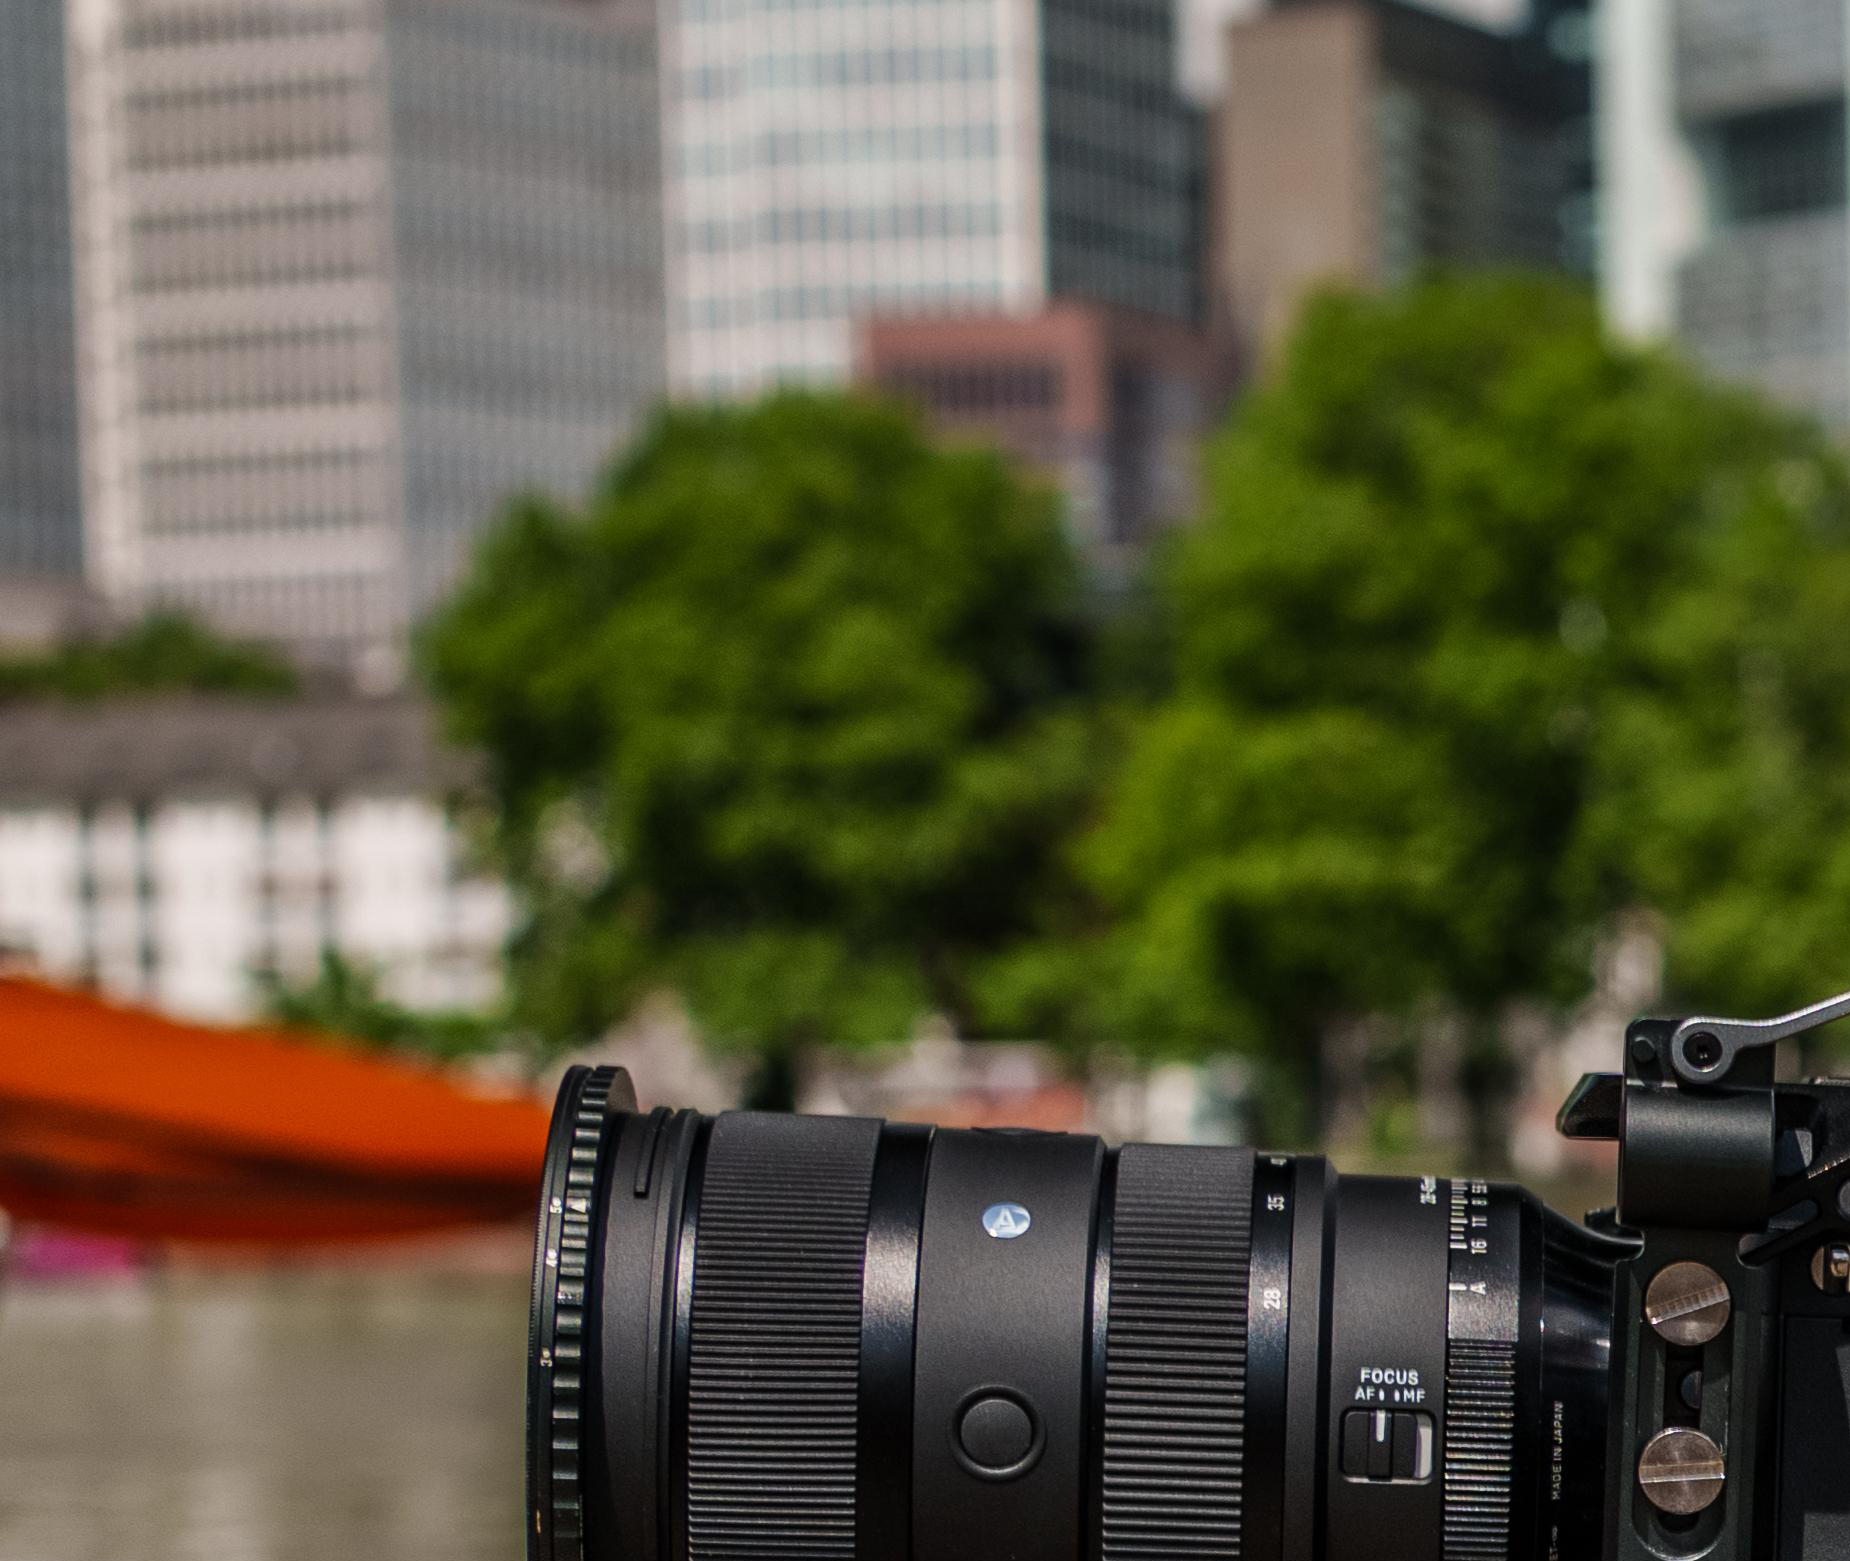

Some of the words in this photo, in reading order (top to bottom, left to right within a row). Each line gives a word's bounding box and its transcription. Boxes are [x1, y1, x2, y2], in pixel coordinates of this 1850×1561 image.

[1267, 1194, 1285, 1211] 35
[992, 1207, 1017, 1229] A
[1471, 1238, 1487, 1254] 16
[1469, 1281, 1486, 1295] A
[1263, 1286, 1281, 1310] 28
[1361, 1366, 1419, 1385] FOCUS
[1355, 1385, 1376, 1401] AF
[1403, 1387, 1426, 1403] MF
[1553, 1401, 1563, 1444] JAPAN
[1553, 1446, 1562, 1461] IN
[1552, 1464, 1561, 1500] MADE
